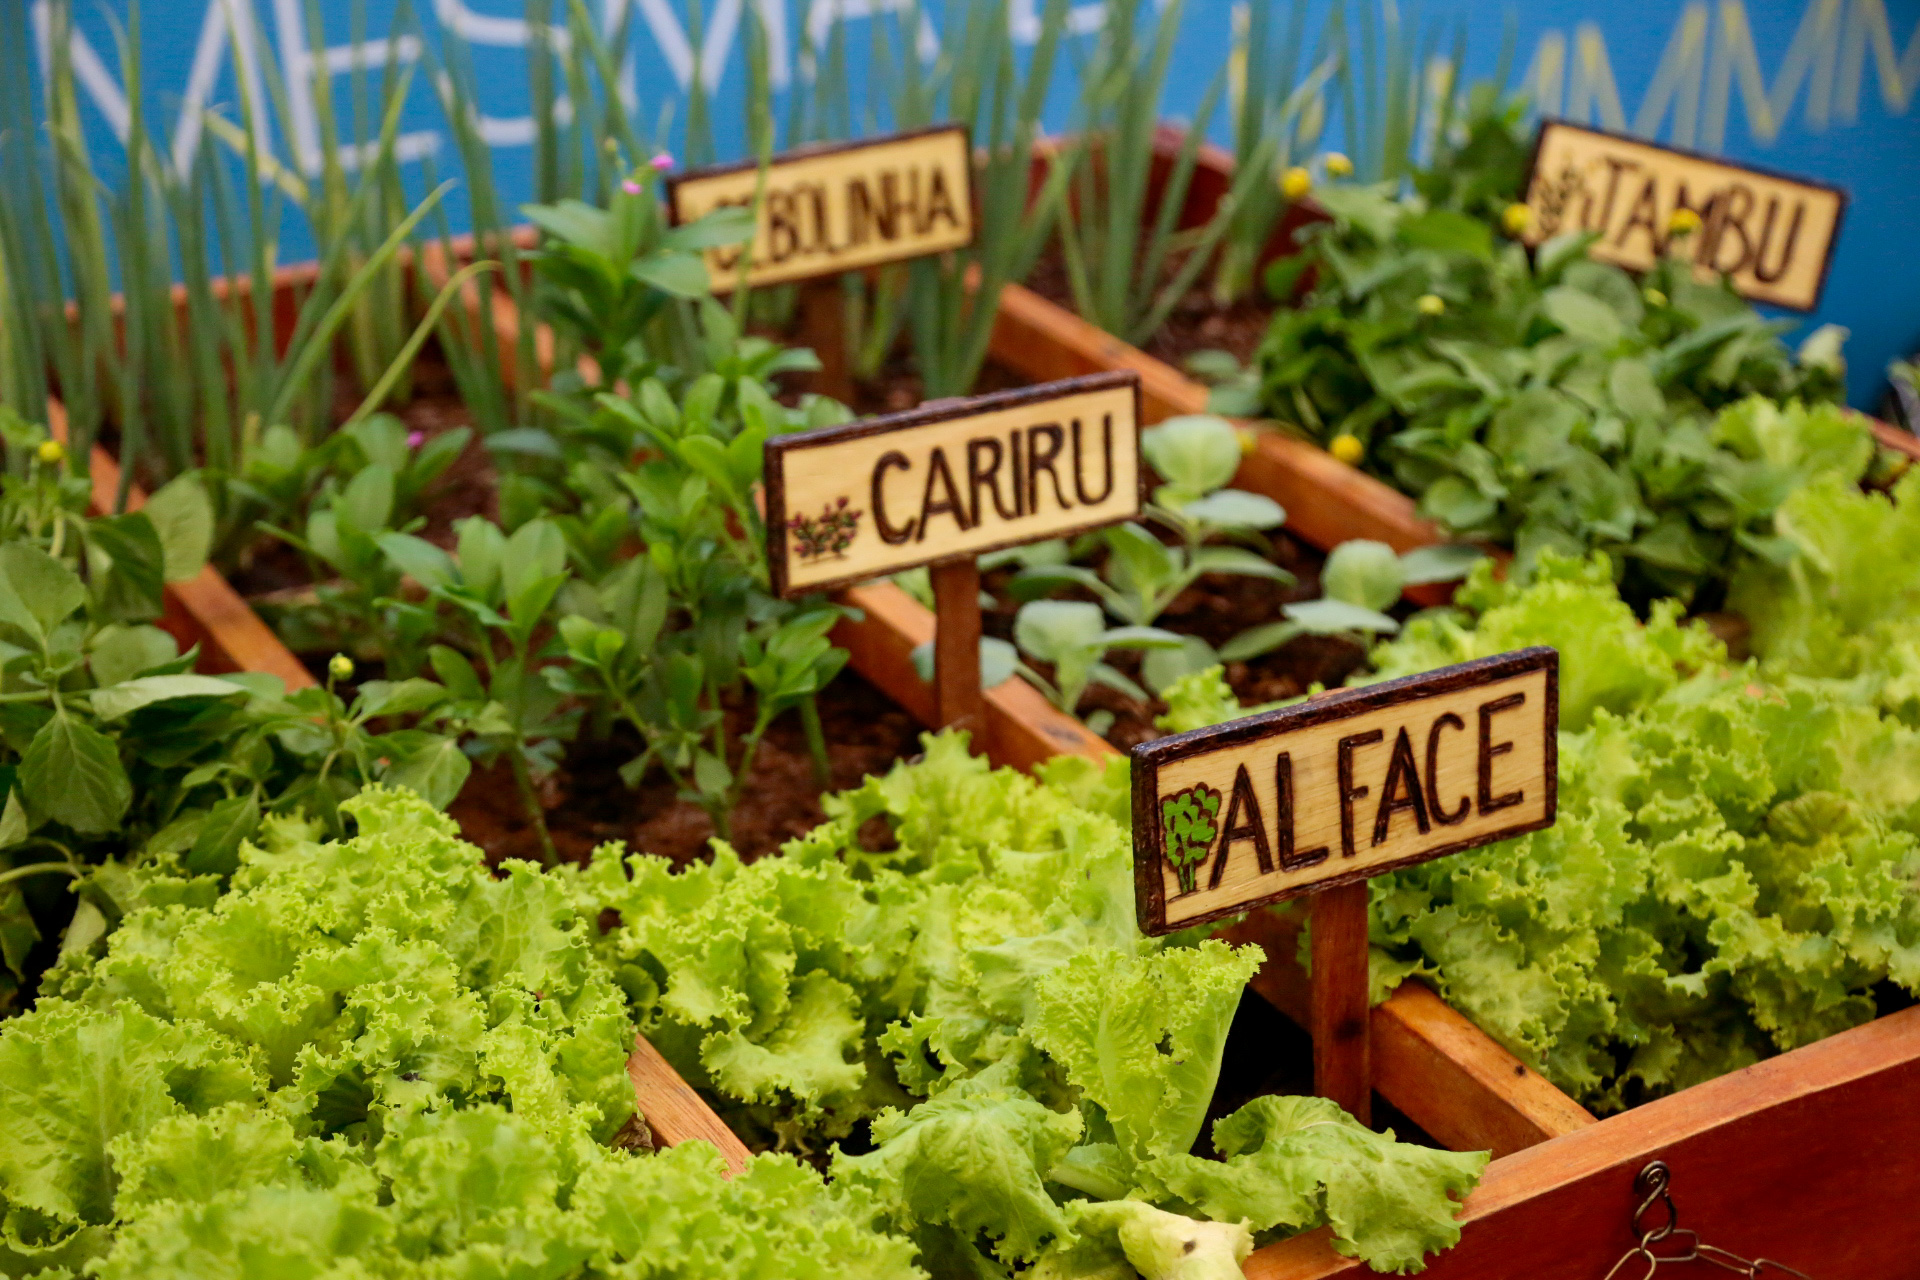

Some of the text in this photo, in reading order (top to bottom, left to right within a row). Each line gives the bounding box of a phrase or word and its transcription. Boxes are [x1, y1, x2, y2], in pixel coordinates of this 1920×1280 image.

[711, 166, 962, 273] BOLINHA
[870, 411, 1113, 546] CARIRU
[1208, 692, 1527, 890] ALFACE
